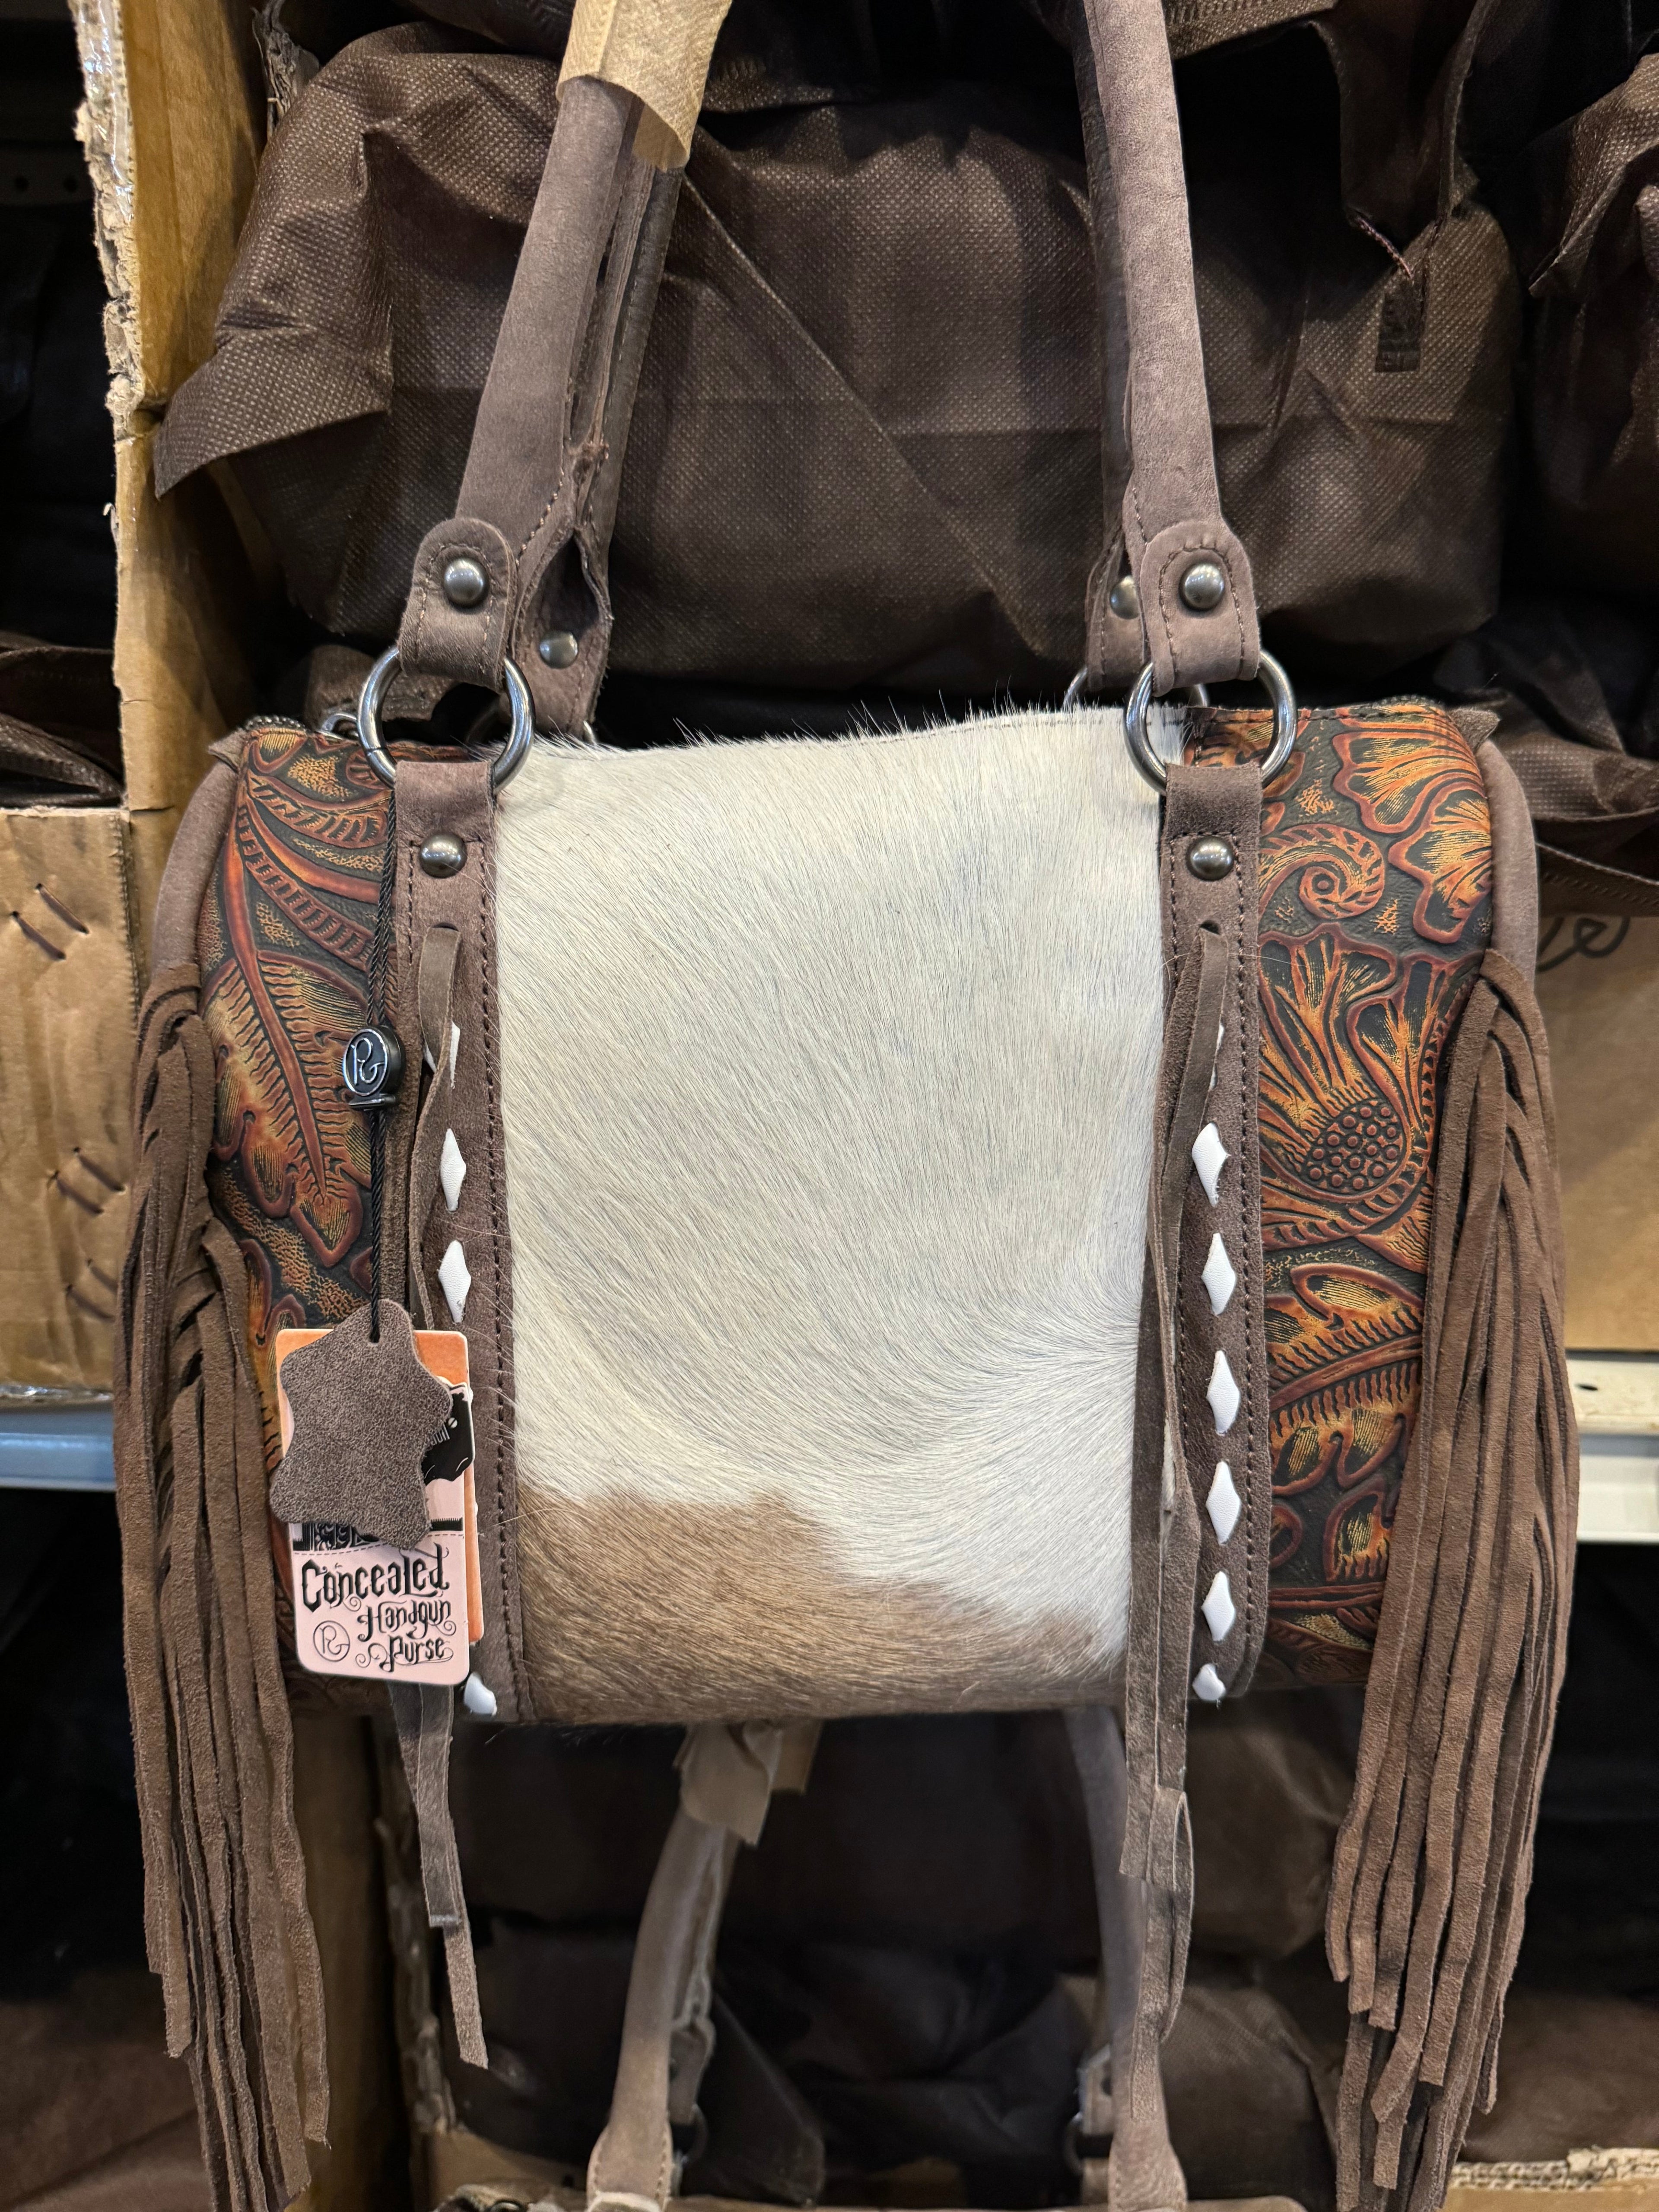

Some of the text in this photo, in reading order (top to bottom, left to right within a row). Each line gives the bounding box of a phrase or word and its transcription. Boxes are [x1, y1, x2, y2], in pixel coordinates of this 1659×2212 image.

[302, 1542, 450, 1612] Concealed
[357, 1599, 457, 1642] Handgun
[356, 1635, 454, 1673] Purse
